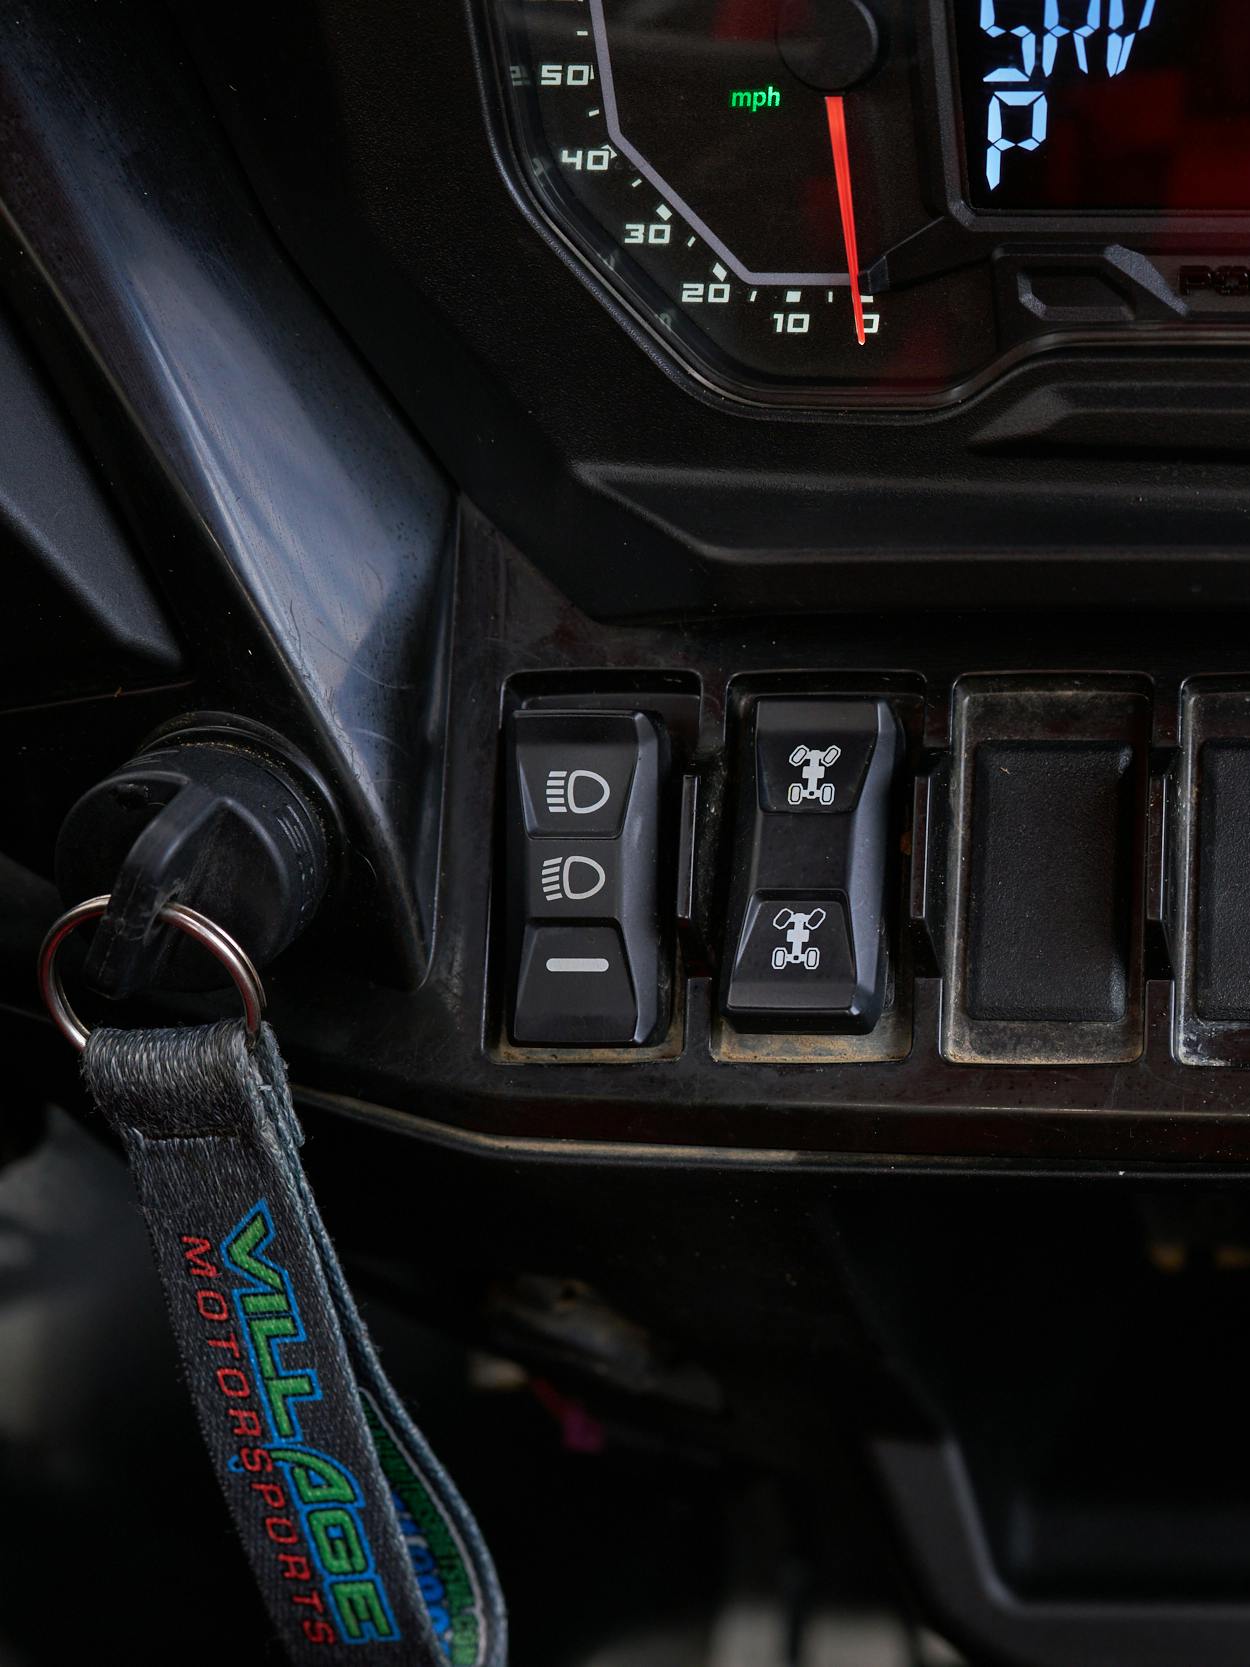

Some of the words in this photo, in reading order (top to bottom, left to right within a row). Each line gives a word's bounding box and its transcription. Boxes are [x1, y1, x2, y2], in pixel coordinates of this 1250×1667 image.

[541, 64, 590, 86] 50
[731, 85, 782, 112] mph
[986, 90, 1048, 192] P
[561, 149, 609, 171] 40
[624, 223, 671, 244] 30
[681, 283, 731, 303] 20
[773, 313, 810, 334] 10
[222, 1197, 401, 1645] VILLAGE
[179, 1233, 338, 1647] MOTORSPORTS
